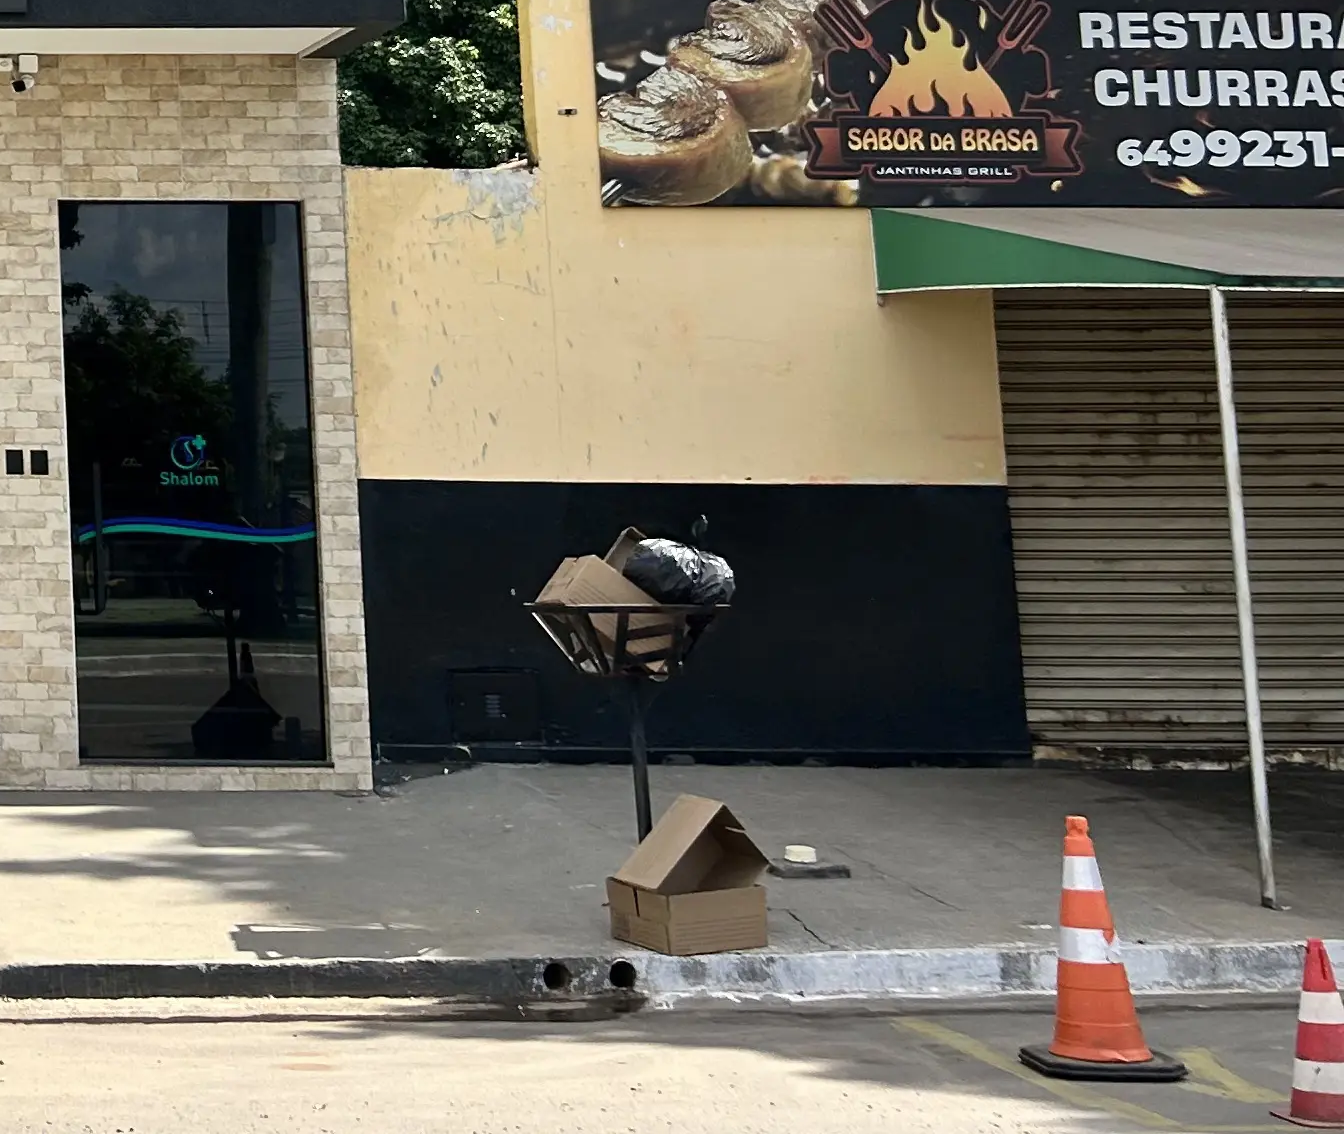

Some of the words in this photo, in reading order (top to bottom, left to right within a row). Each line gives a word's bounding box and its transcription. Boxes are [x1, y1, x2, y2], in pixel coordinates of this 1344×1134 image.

[1078, 12, 1344, 49] RESTAUR
[847, 127, 925, 151] SABOR
[930, 132, 955, 151] DA
[961, 128, 1038, 152] BRASA
[876, 166, 962, 176] JANTINHAS
[968, 166, 1013, 176] GRILL
[160, 471, 219, 486] Shalom
